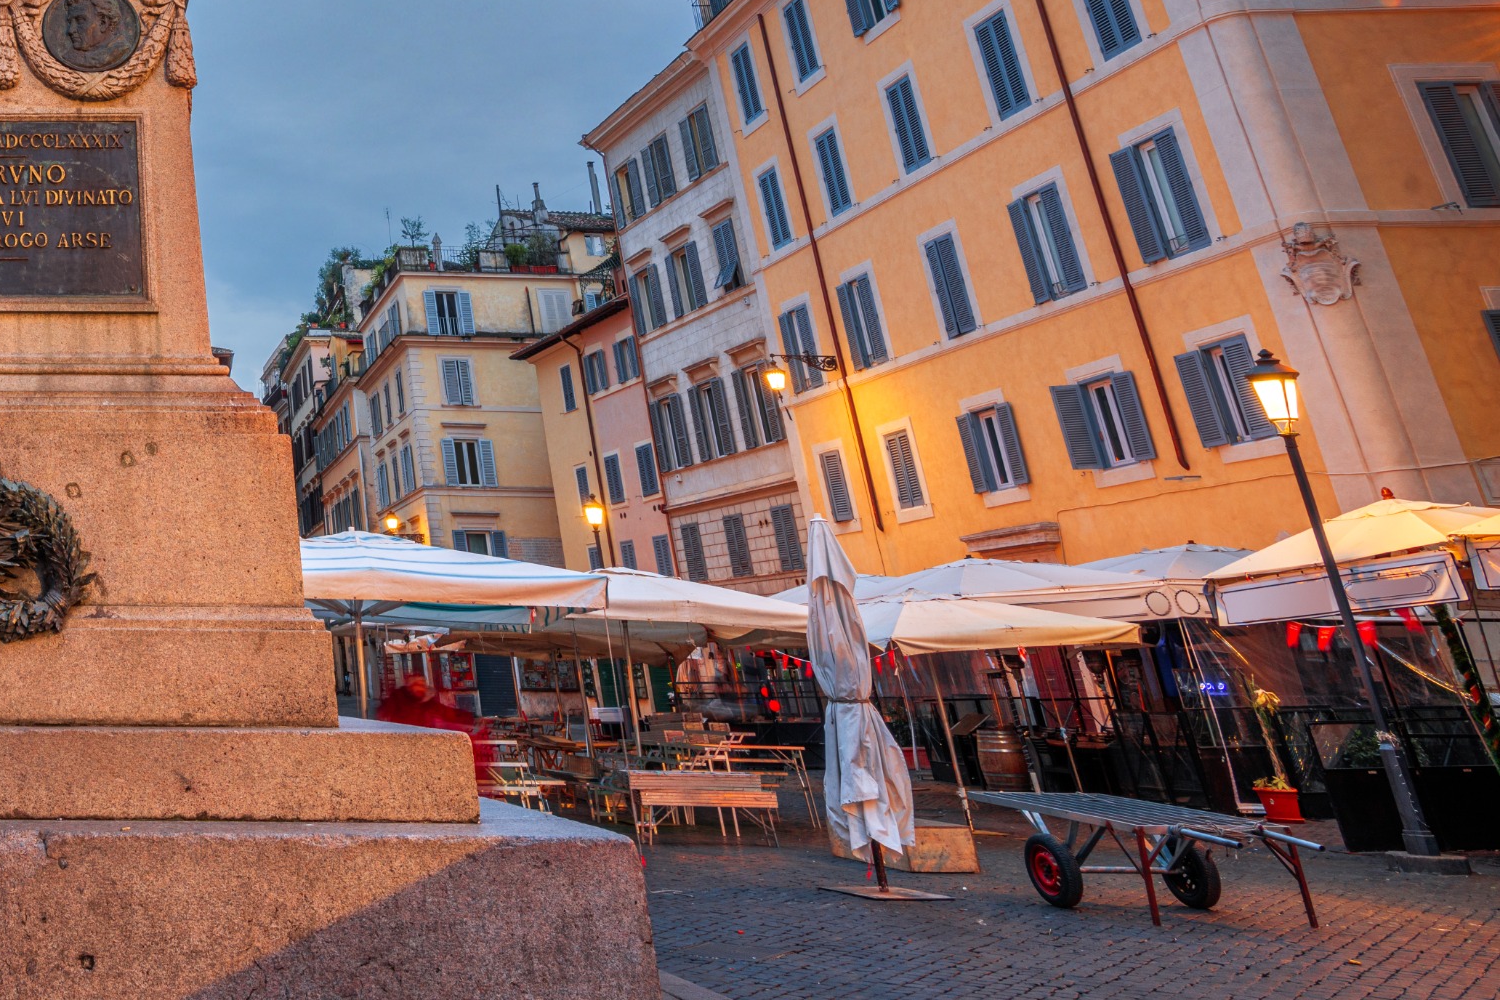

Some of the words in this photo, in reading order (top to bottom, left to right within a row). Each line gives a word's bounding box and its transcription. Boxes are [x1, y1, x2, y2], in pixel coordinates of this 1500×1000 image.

[11, 190, 39, 206] LVI
[46, 189, 133, 205] DIVINATO
[57, 232, 112, 249] ARSE
